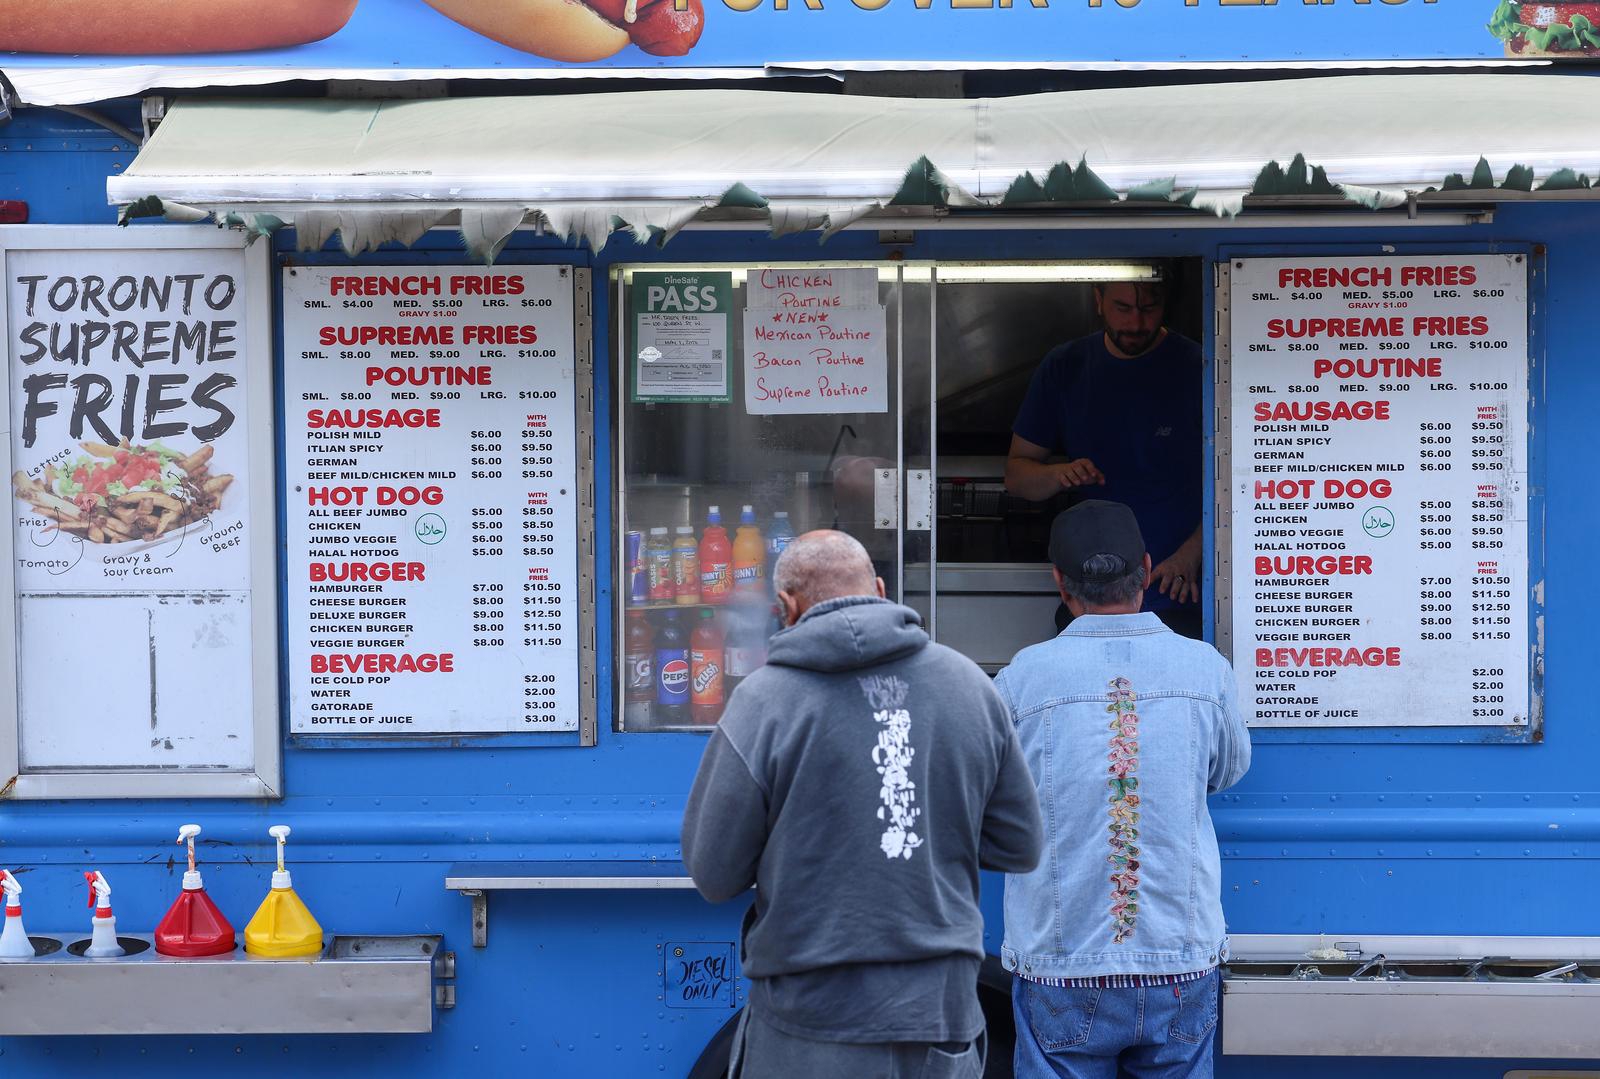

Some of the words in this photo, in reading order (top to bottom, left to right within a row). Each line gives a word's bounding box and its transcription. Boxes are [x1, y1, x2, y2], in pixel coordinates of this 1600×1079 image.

[760, 269, 832, 289] CHICKEN
[1279, 267, 1391, 288] FRENCH
[1401, 266, 1476, 286] FRIES
[331, 276, 441, 296] FRENCH
[450, 275, 524, 295] FRIES
[17, 274, 236, 317] TORONTO
[648, 286, 717, 311] PASS
[778, 293, 841, 308] POUTINE
[303, 300, 331, 309] SML.
[342, 300, 374, 309] $4.00
[393, 299, 422, 308] MED.
[432, 299, 463, 308] $5.00
[482, 299, 509, 307] LRG.
[521, 298, 553, 308] $6.00
[398, 310, 431, 318] GRAVY
[432, 310, 458, 318] $1.00
[320, 326, 454, 345] SUPREME
[463, 325, 537, 345] FRIES
[755, 326, 811, 342] Mexican
[816, 325, 872, 341] Poutine
[20, 320, 237, 368] SUPREME
[301, 351, 329, 360] SML.
[339, 350, 371, 360] $8.00
[390, 350, 419, 359] MED.
[429, 350, 460, 359] $9.00
[479, 349, 507, 358] LRG.
[518, 349, 557, 359] $10.00
[753, 351, 801, 369] Bacon
[809, 348, 865, 366] Poutine
[366, 366, 491, 386] POUTINE
[302, 392, 329, 401] SML.
[340, 392, 372, 401] $8.00
[391, 392, 420, 400] MED.
[429, 391, 461, 401] $9.00
[480, 391, 507, 399] LRG.
[518, 390, 557, 400] $10.00
[754, 377, 811, 403] Supreme
[818, 376, 868, 397] Poutine
[22, 372, 237, 451] FRIES
[308, 409, 440, 428] SAUSAGE
[307, 431, 350, 440] POLISH
[353, 431, 382, 439] MILD
[470, 430, 502, 439] $6.00
[521, 429, 553, 439] $9.50
[307, 444, 346, 453] ITLIAN
[349, 444, 384, 453] SPICY
[470, 443, 502, 452] $6.00
[521, 443, 553, 452] $9.50
[26, 447, 72, 478] Lettuce
[307, 458, 358, 467] GERMAN
[471, 457, 502, 466] $6.00
[521, 456, 553, 466] $9.50
[307, 471, 337, 480] BEEF
[340, 471, 425, 480] MILD/CHICKEN
[428, 471, 457, 479] MILD
[471, 470, 503, 479] $6.00
[522, 470, 553, 479] $9.50
[309, 487, 368, 506] HOT
[377, 486, 443, 505] DOG
[1255, 480, 1315, 499] HOT
[1324, 479, 1392, 498] DOG
[1253, 502, 1277, 511] ALL
[1279, 502, 1310, 511] BEEF
[1312, 501, 1355, 510] JUMBO
[1420, 500, 1452, 510] $5.00
[1471, 498, 1505, 509] $8.50
[18, 517, 48, 527] Fries
[1254, 515, 1308, 524] CHICKEN
[1420, 514, 1452, 523] $5.00
[1471, 513, 1504, 523] $8.50
[199, 520, 244, 546] Ground
[1254, 529, 1296, 538] JUMBO
[1299, 529, 1344, 537] VEGGIE
[1420, 527, 1452, 537] $6.00
[1471, 527, 1503, 536] $9.50
[212, 536, 242, 554] Beef
[1254, 542, 1293, 551] HALAL
[1296, 542, 1346, 551] HOTDOG
[1420, 541, 1452, 550] $5.00
[1471, 540, 1504, 550] $8.50
[18, 559, 69, 569] Tomato
[103, 554, 140, 567] Gravy
[144, 553, 151, 563] &
[1255, 556, 1372, 575] BURGER
[103, 565, 129, 577] Sour
[133, 565, 173, 576] Cream
[310, 562, 425, 582] BURGER
[1254, 578, 1330, 587] HAMBURGER
[1420, 577, 1452, 586] $7.00
[1471, 576, 1511, 585] $10.50
[1254, 591, 1302, 600] CHEESE
[1304, 591, 1353, 600] BURGER
[1420, 590, 1452, 599] $8.00
[1471, 590, 1511, 599] $11.50
[1254, 605, 1301, 613] DELUXE
[1304, 604, 1353, 613] BURGER
[1420, 603, 1452, 612] $9.00
[1472, 603, 1511, 612] $12.50
[1254, 618, 1308, 627] CHICKEN
[1311, 618, 1361, 627] BURGER
[1420, 617, 1452, 626] $8.00
[1472, 616, 1511, 626] $11.50
[1254, 633, 1299, 642] VEGGIE
[1302, 633, 1351, 641] BURGER
[1420, 632, 1452, 641] $8.00
[1472, 631, 1511, 641] $11.50
[311, 654, 453, 673] BEVERAGE
[1256, 647, 1400, 667] BEVERAGE
[664, 671, 688, 681] PEPS
[693, 663, 719, 693] Crush
[1255, 670, 1275, 678] ICE
[1278, 670, 1310, 678] COLD
[1313, 669, 1337, 678] POP
[1472, 668, 1504, 677] $2.00
[1255, 683, 1296, 692] WATER
[1472, 681, 1504, 690] $2.00
[1255, 696, 1319, 705] GATORADE
[1472, 695, 1504, 704] $3.00
[1255, 710, 1302, 719] BOTTLE
[1304, 710, 1321, 718] OF
[1323, 709, 1359, 718] JUICE
[1472, 708, 1504, 717] $3.00
[683, 982, 722, 1000] ONLY
